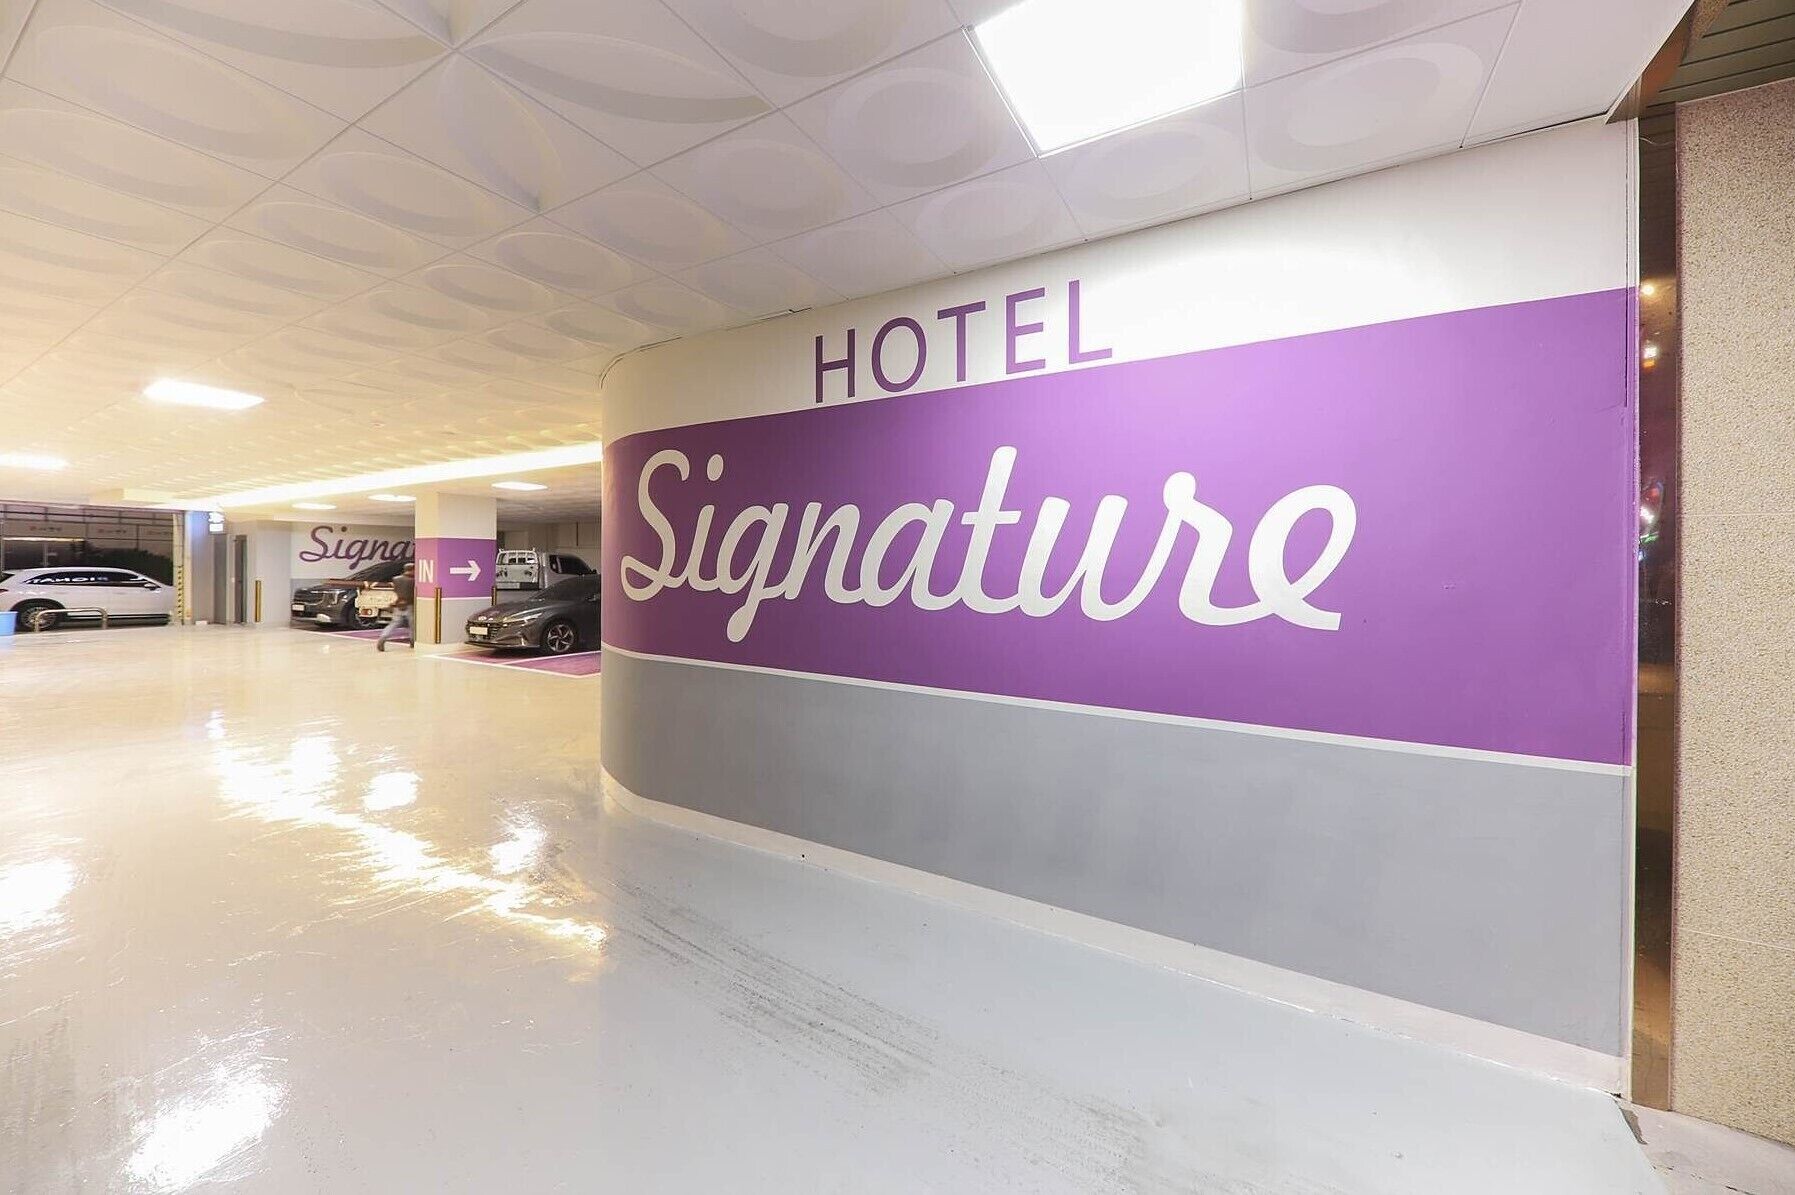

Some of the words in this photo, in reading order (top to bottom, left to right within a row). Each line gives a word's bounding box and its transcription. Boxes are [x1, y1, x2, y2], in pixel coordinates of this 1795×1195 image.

[815, 279, 1113, 403] HOTEL
[300, 525, 415, 570] Signa
[419, 559, 434, 583] IN
[620, 446, 1358, 643] Signature
